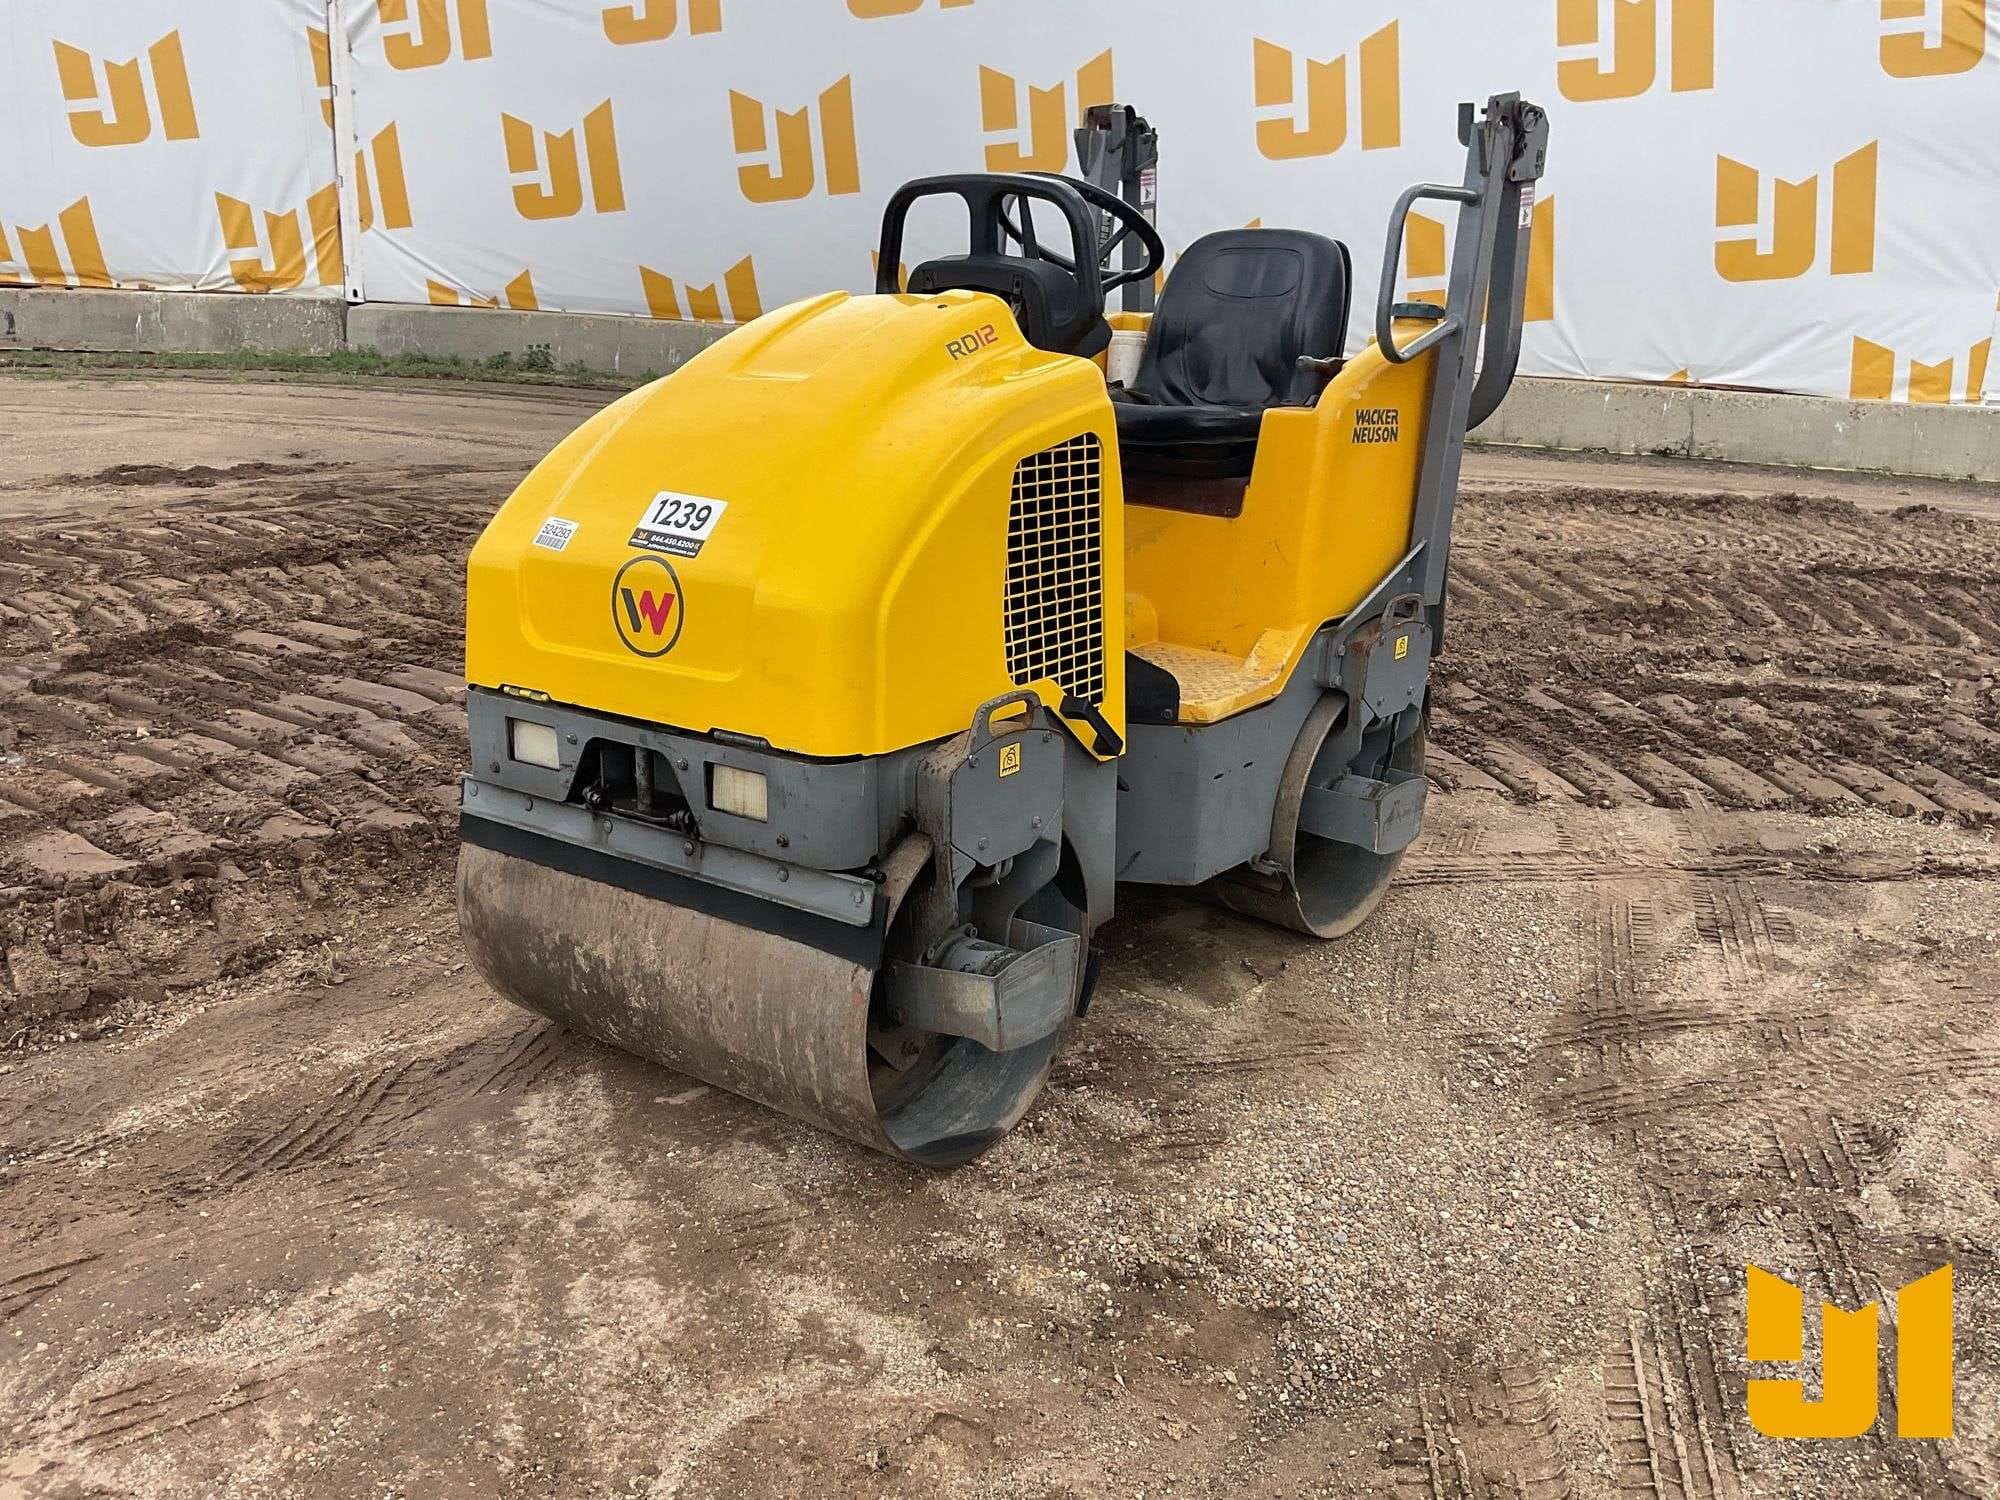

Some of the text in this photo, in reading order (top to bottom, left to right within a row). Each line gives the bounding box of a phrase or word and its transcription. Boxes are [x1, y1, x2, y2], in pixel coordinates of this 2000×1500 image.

[945, 324, 998, 360] RD12
[1355, 408, 1399, 425] WACKER
[1352, 426, 1399, 443] NEUSON
[651, 498, 712, 531] 1239
[542, 523, 572, 539] 524293
